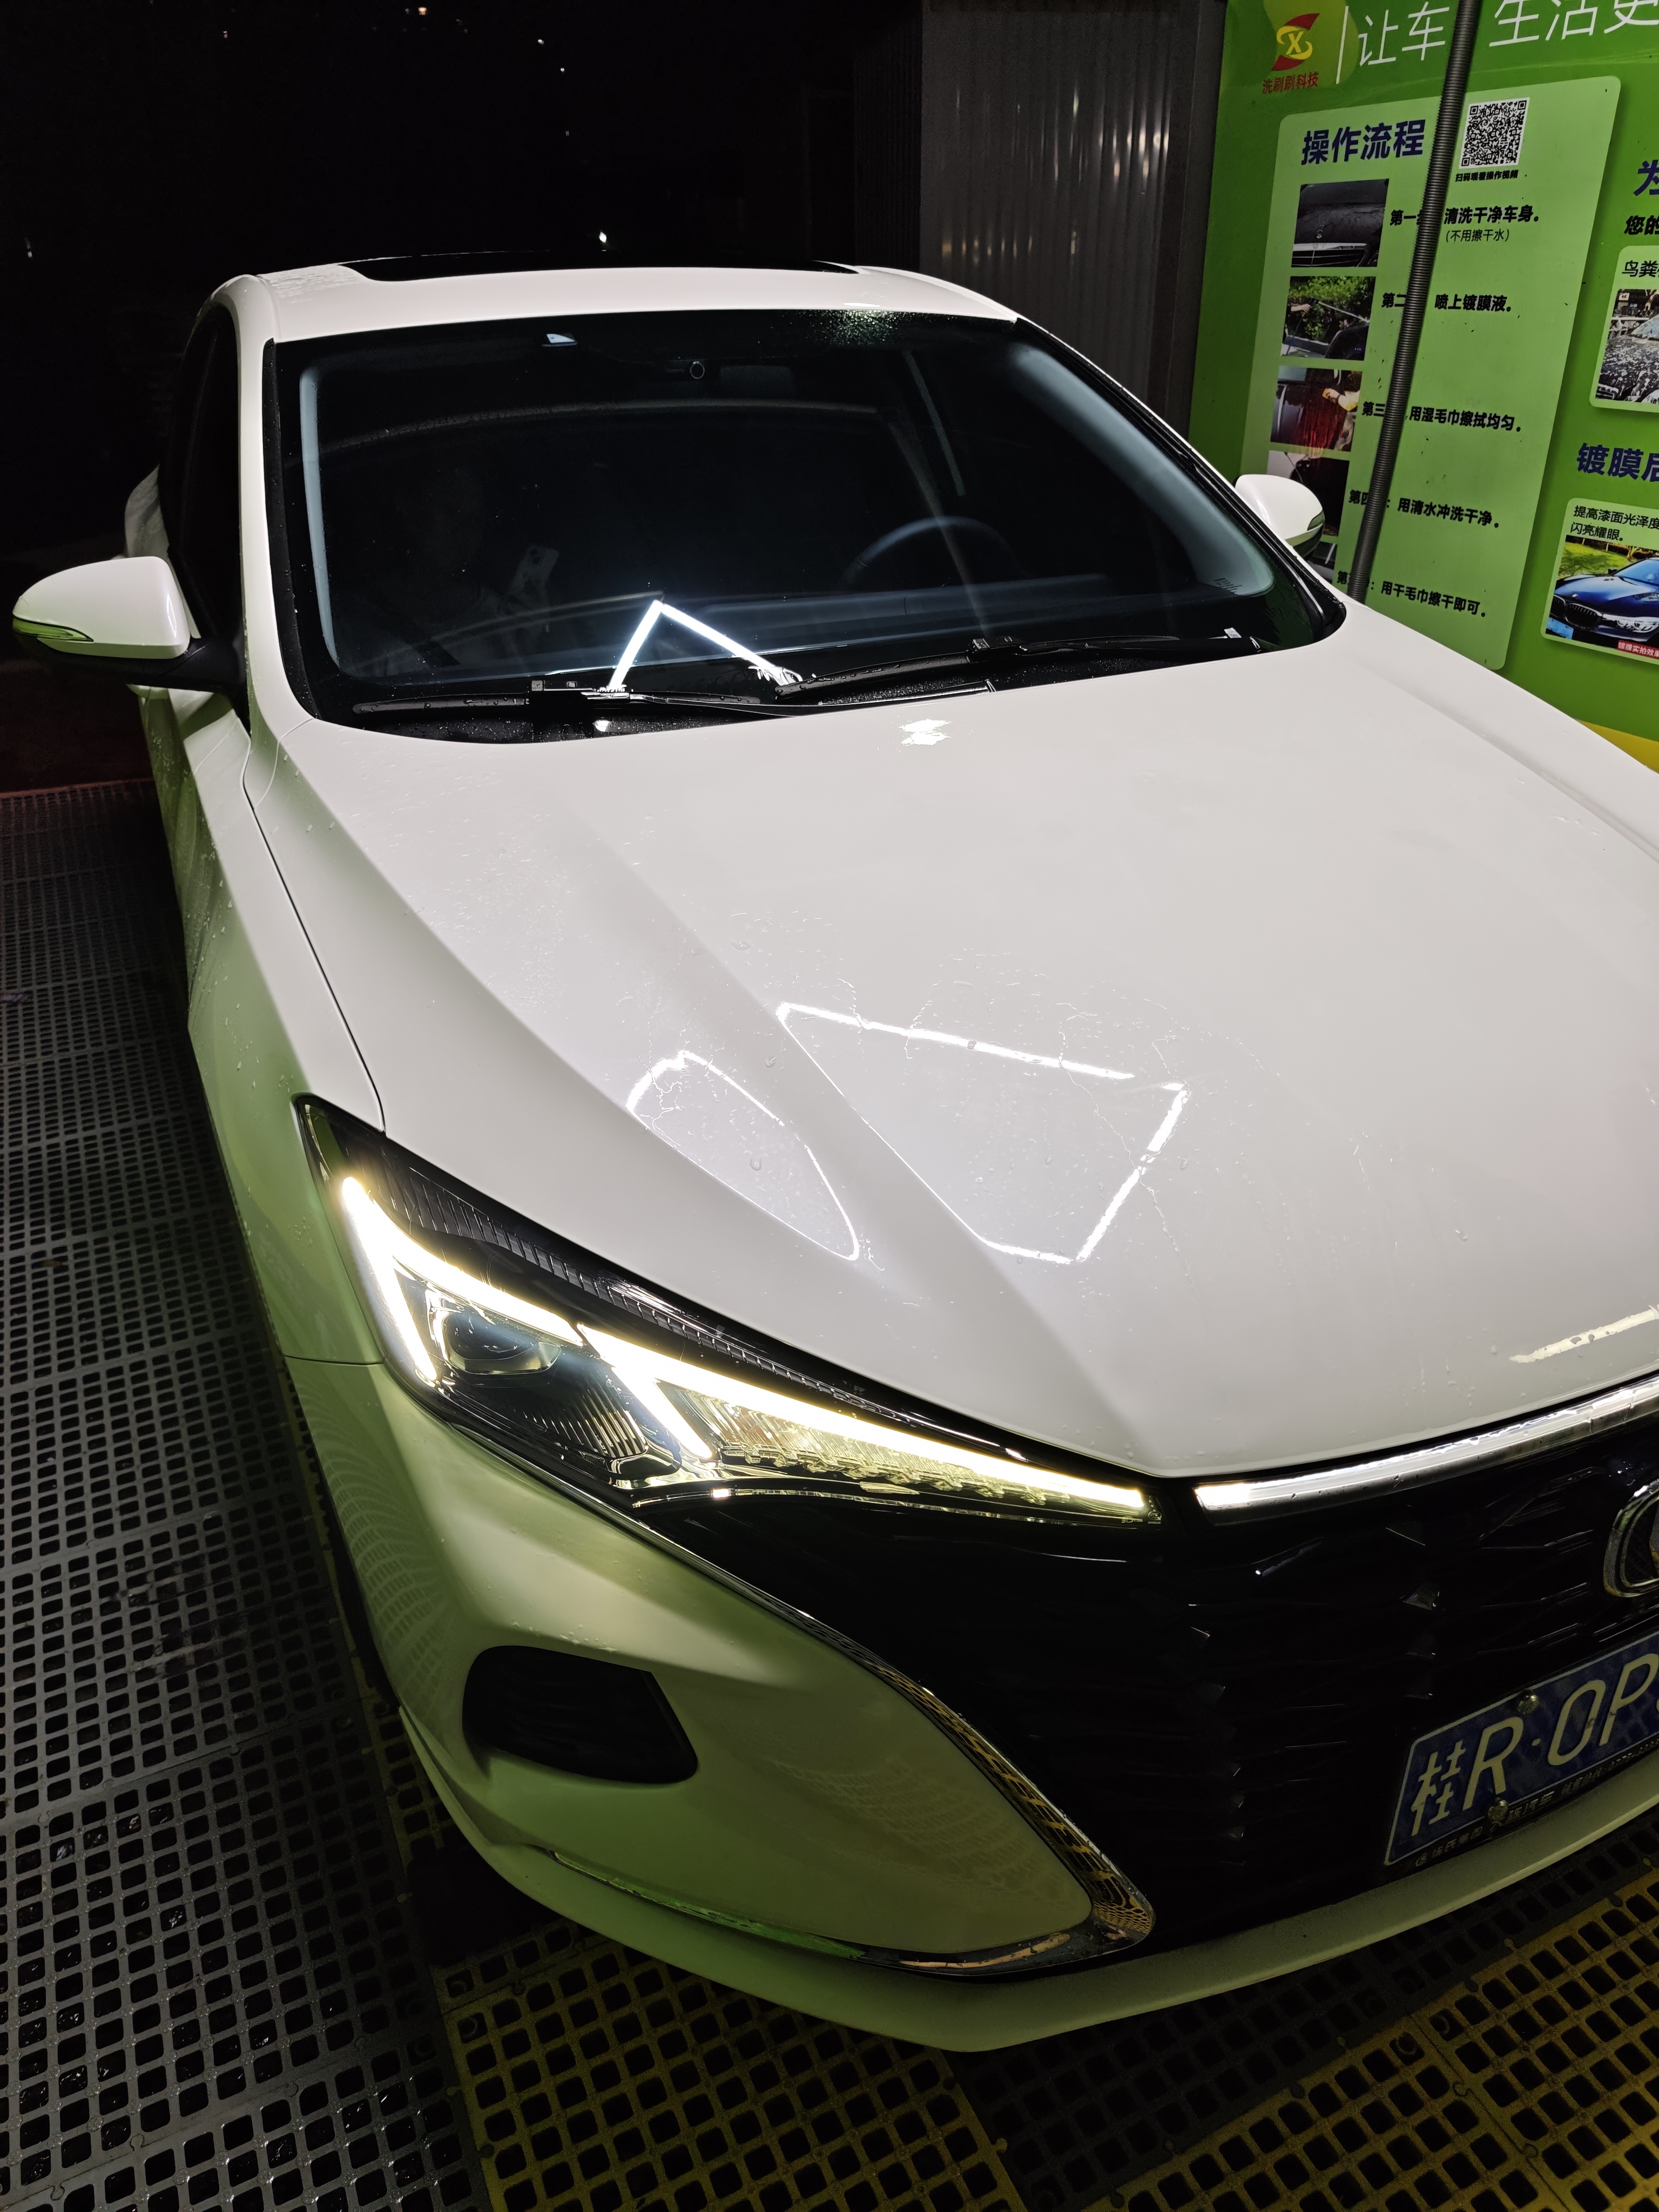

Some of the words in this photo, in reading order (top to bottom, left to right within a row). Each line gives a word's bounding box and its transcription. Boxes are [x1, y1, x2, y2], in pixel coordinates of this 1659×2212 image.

[1262, 72, 1319, 95] 洗刷刷科技
[1301, 119, 1426, 166] 操作流程
[1455, 170, 1519, 183] 扫码观看操作视频
[1621, 260, 1659, 278] 鸟粪
